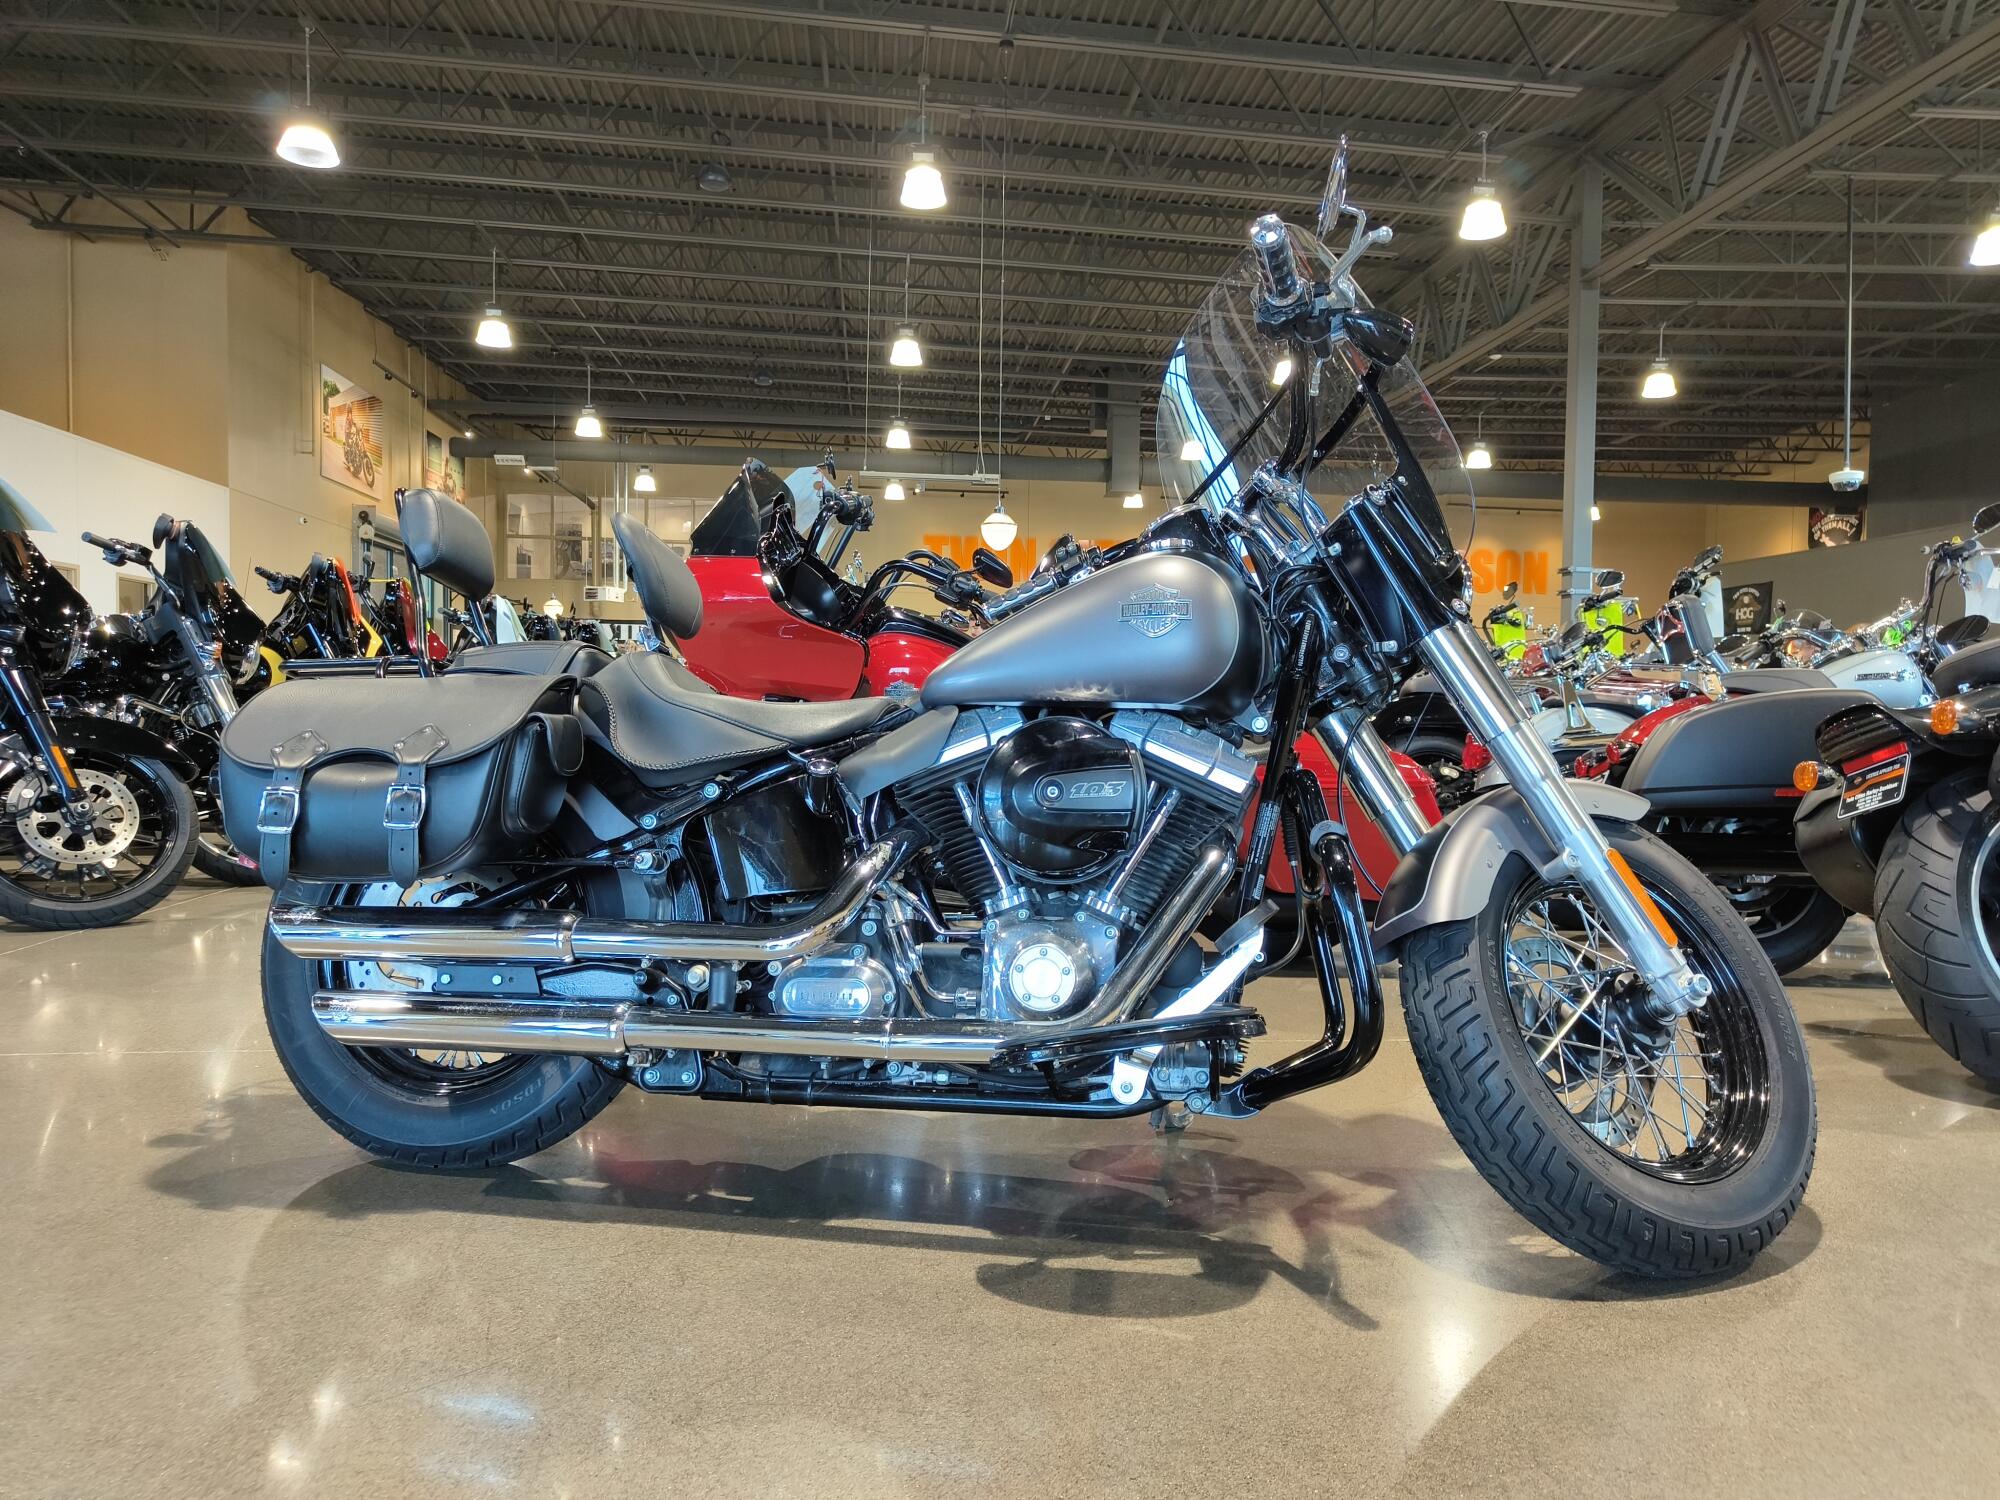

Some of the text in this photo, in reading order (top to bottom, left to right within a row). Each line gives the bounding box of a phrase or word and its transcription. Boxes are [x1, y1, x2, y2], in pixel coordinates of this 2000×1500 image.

[1123, 603, 1188, 617] HARLEY-DAVIDSON
[1735, 607, 1754, 621] HOG
[1070, 780, 1127, 799] 103
